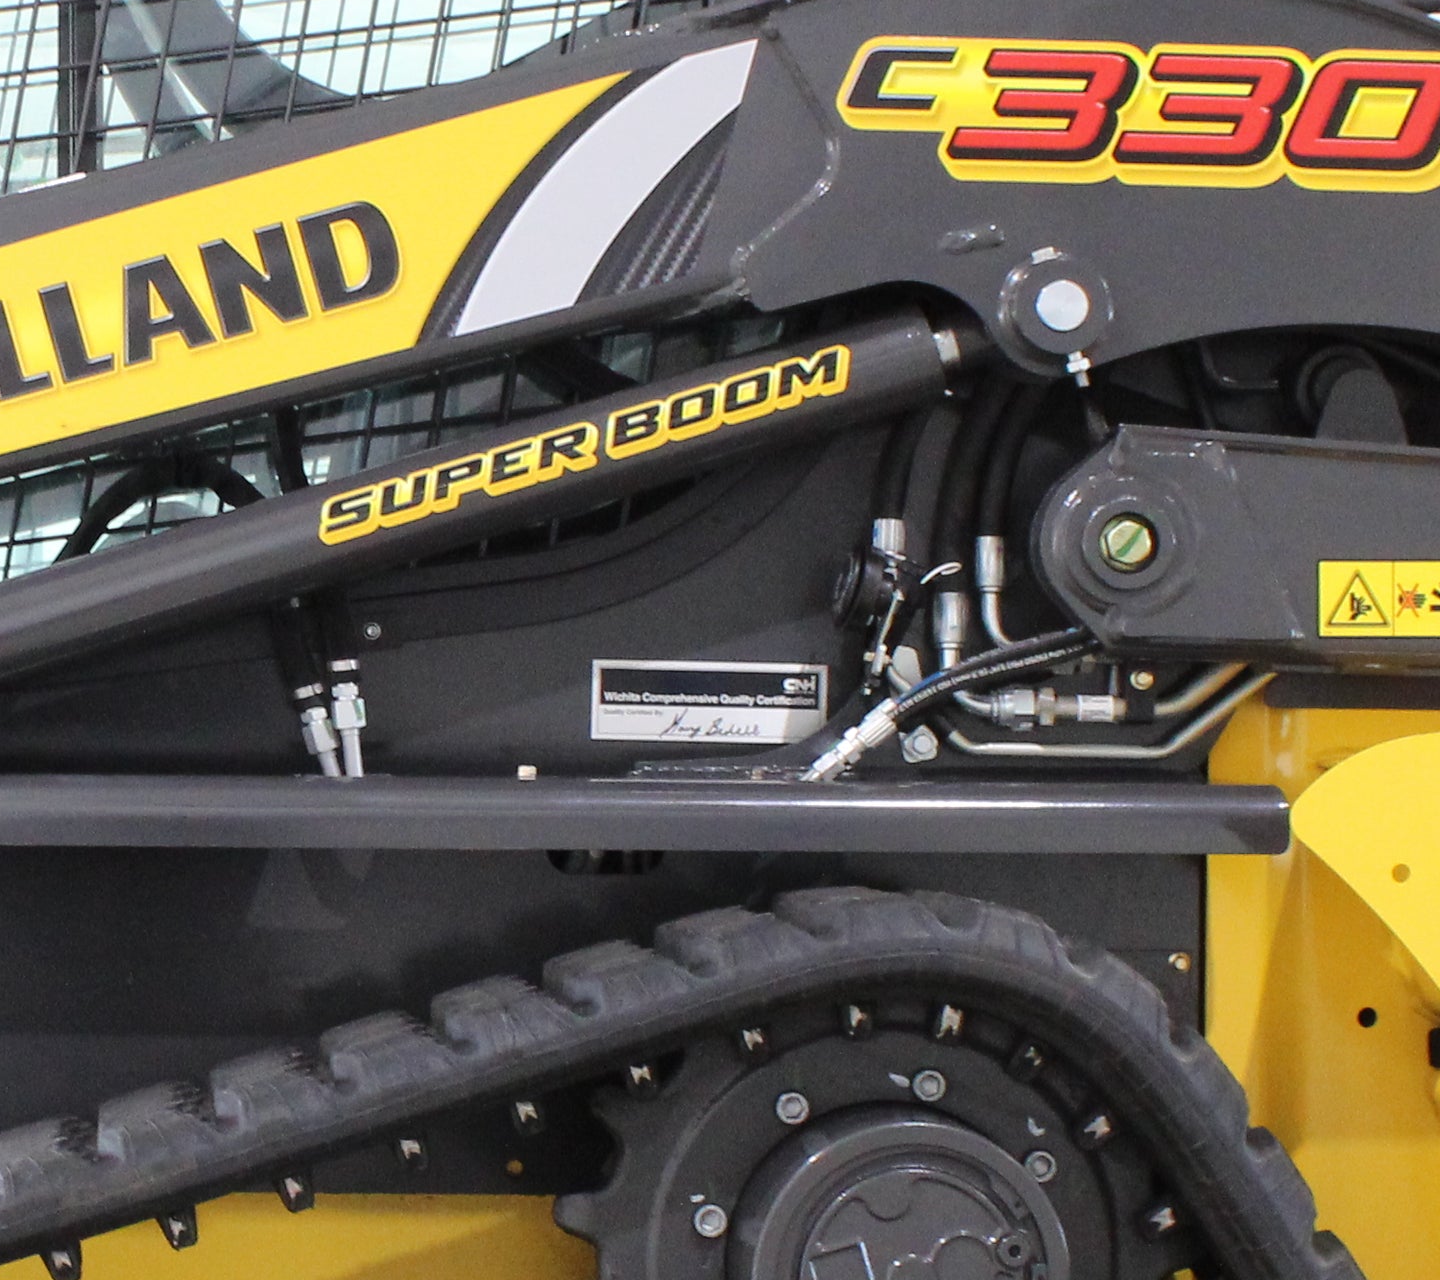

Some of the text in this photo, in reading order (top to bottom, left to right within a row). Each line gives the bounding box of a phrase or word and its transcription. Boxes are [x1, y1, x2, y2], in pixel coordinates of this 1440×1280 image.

[323, 347, 847, 540] SUPER BOOM
[782, 675, 816, 693] CNH
[604, 691, 815, 707] Wichita Comprehensive Quality Certification
